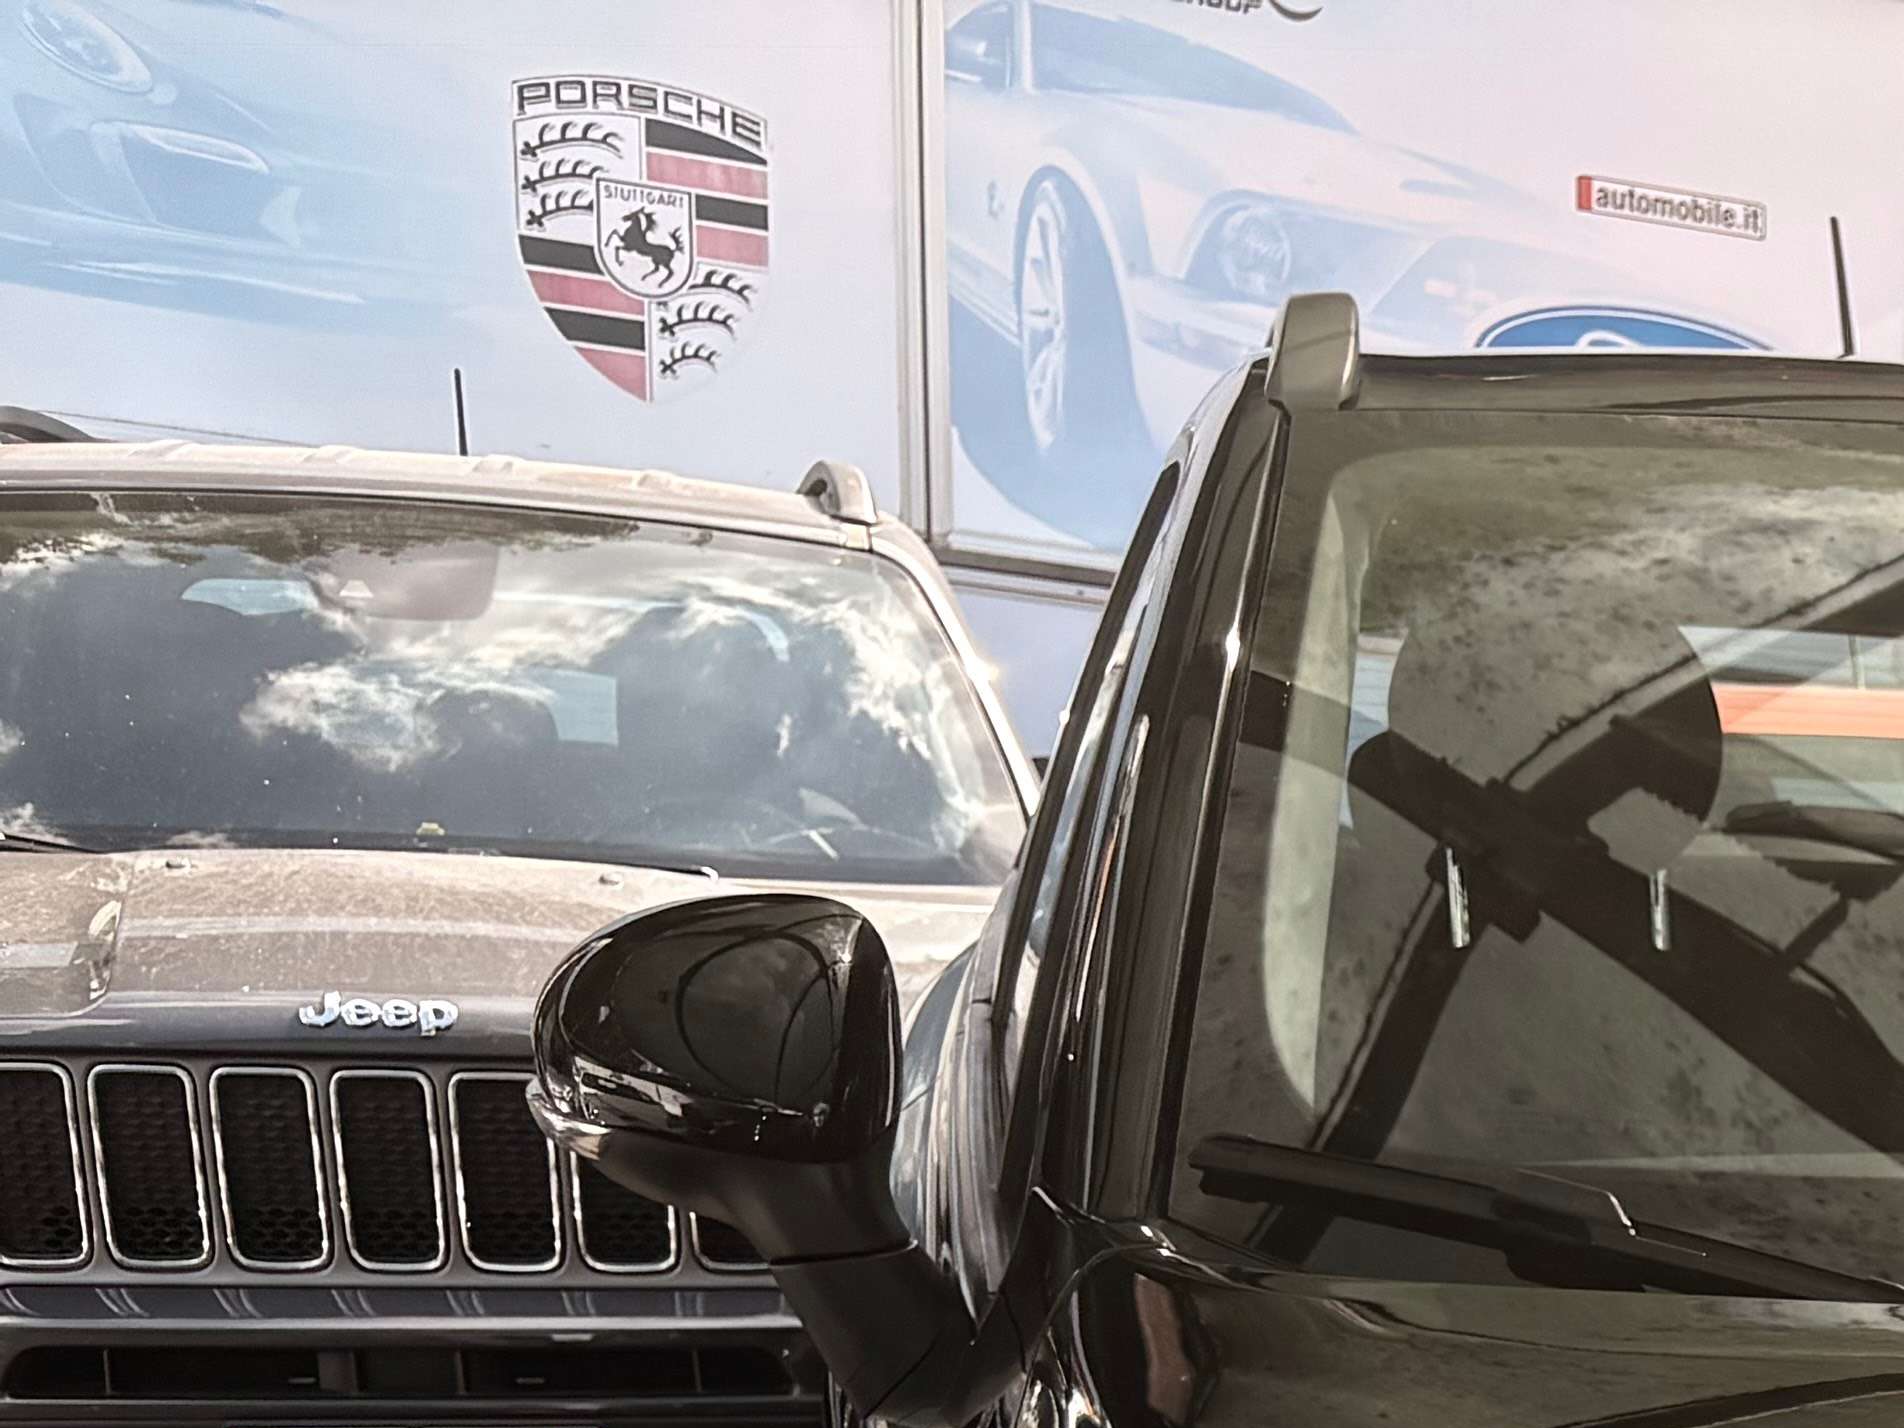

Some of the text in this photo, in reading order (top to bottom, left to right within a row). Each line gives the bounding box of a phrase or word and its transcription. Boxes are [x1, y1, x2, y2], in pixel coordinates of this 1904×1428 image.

[517, 80, 762, 151] PORSCHE
[603, 184, 685, 209] STUTTGART
[1596, 186, 1760, 234] automobile.it
[299, 992, 459, 1035] Jeep
